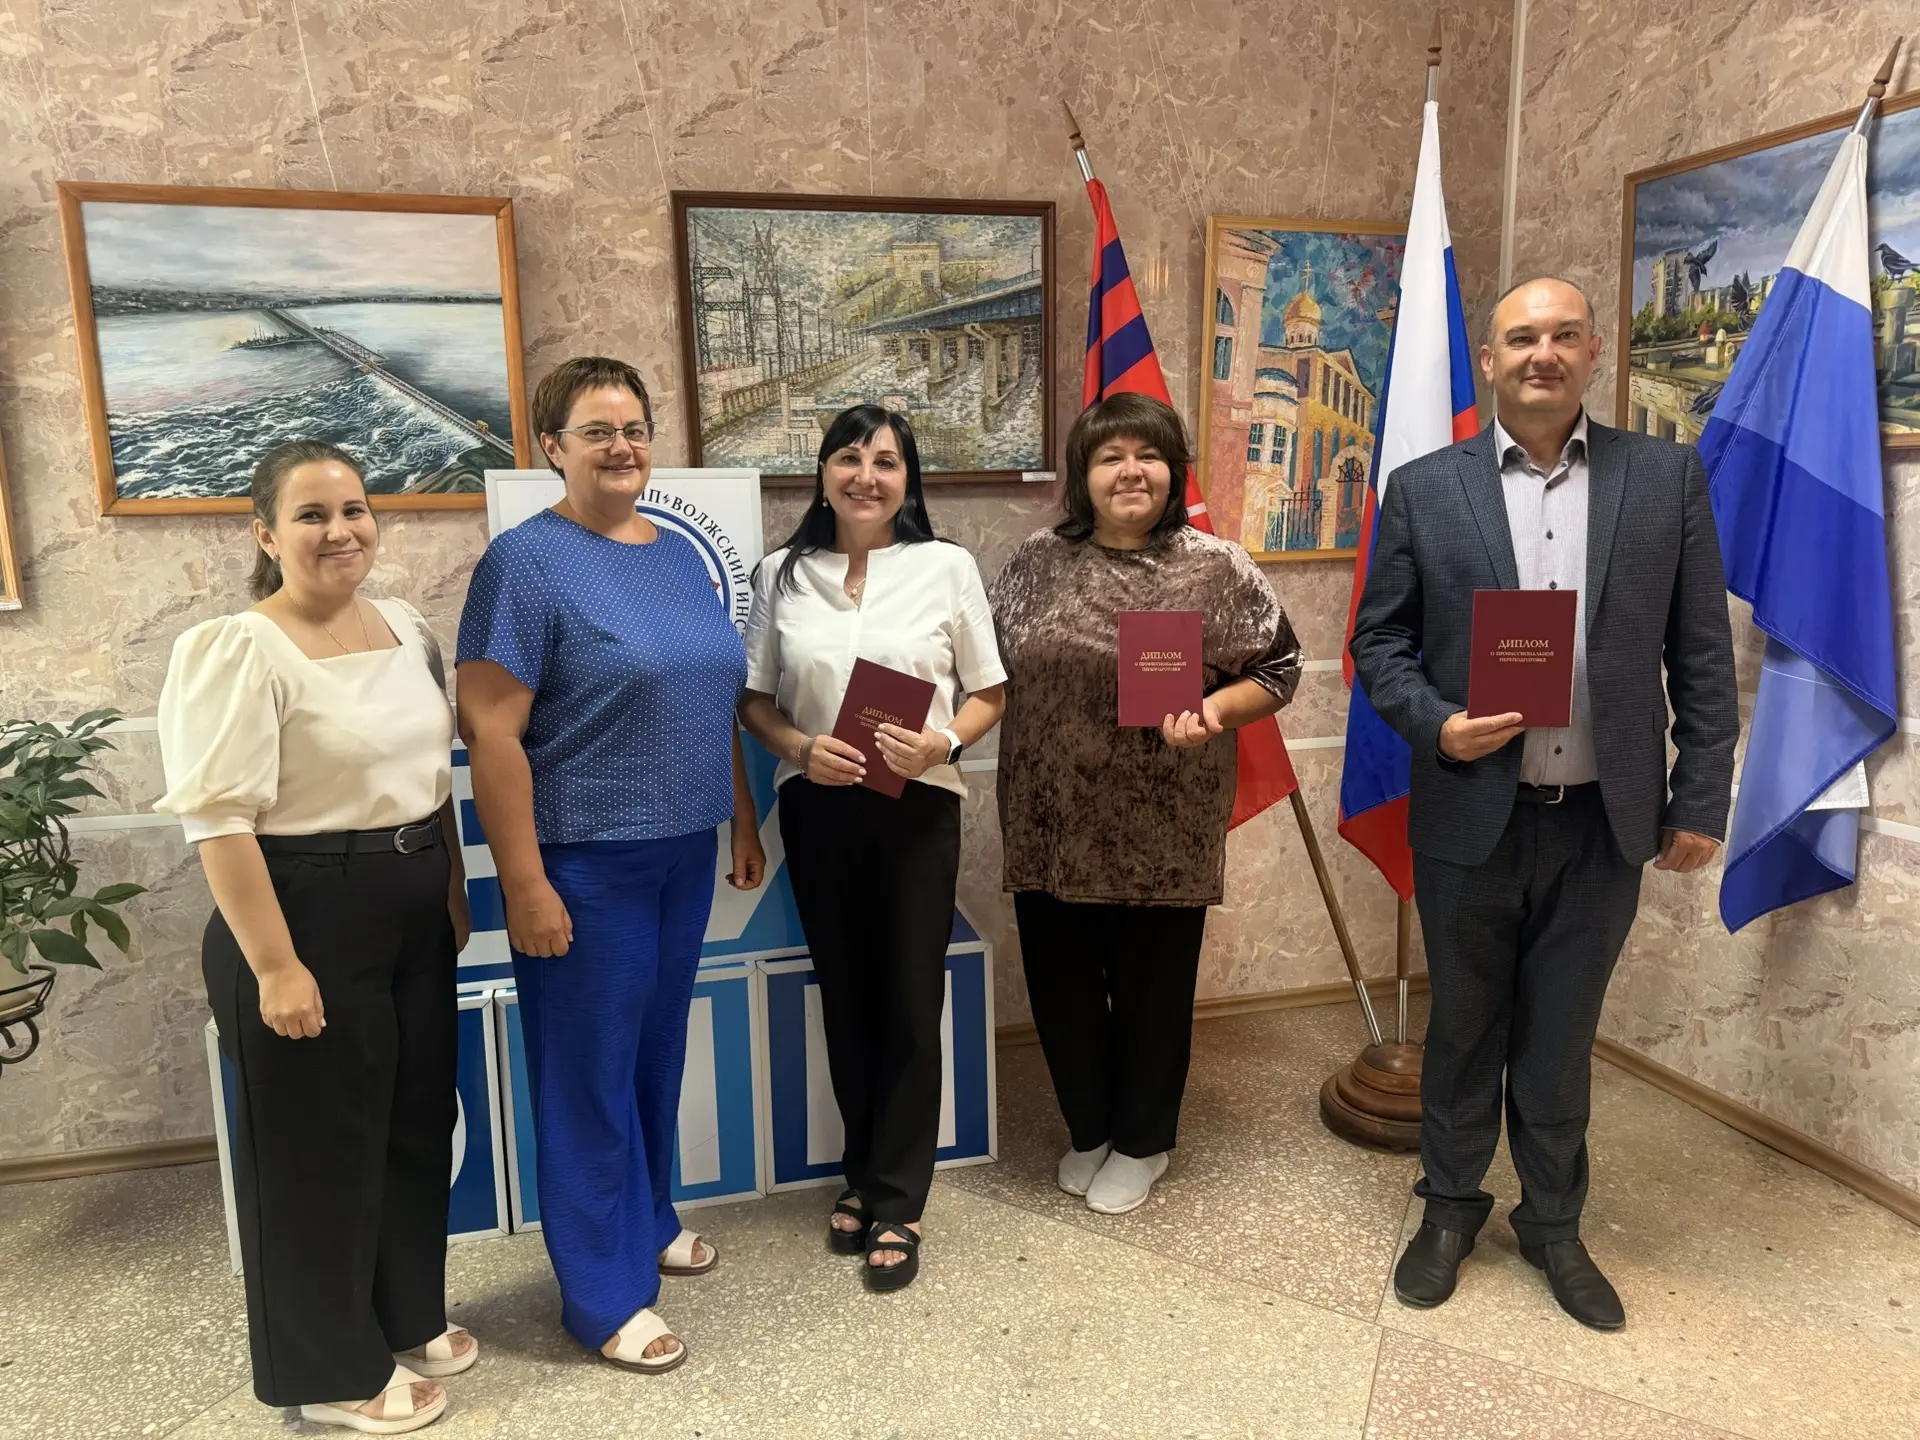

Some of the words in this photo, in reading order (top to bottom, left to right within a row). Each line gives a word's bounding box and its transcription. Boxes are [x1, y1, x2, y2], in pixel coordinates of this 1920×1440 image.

[670, 496, 751, 586] ВОЛЖСКИЙ
[1498, 639, 1549, 649] ДИПЛОМ
[1140, 651, 1182, 660] ДИПЛОМ
[861, 705, 904, 726] ДИПЛОМ
